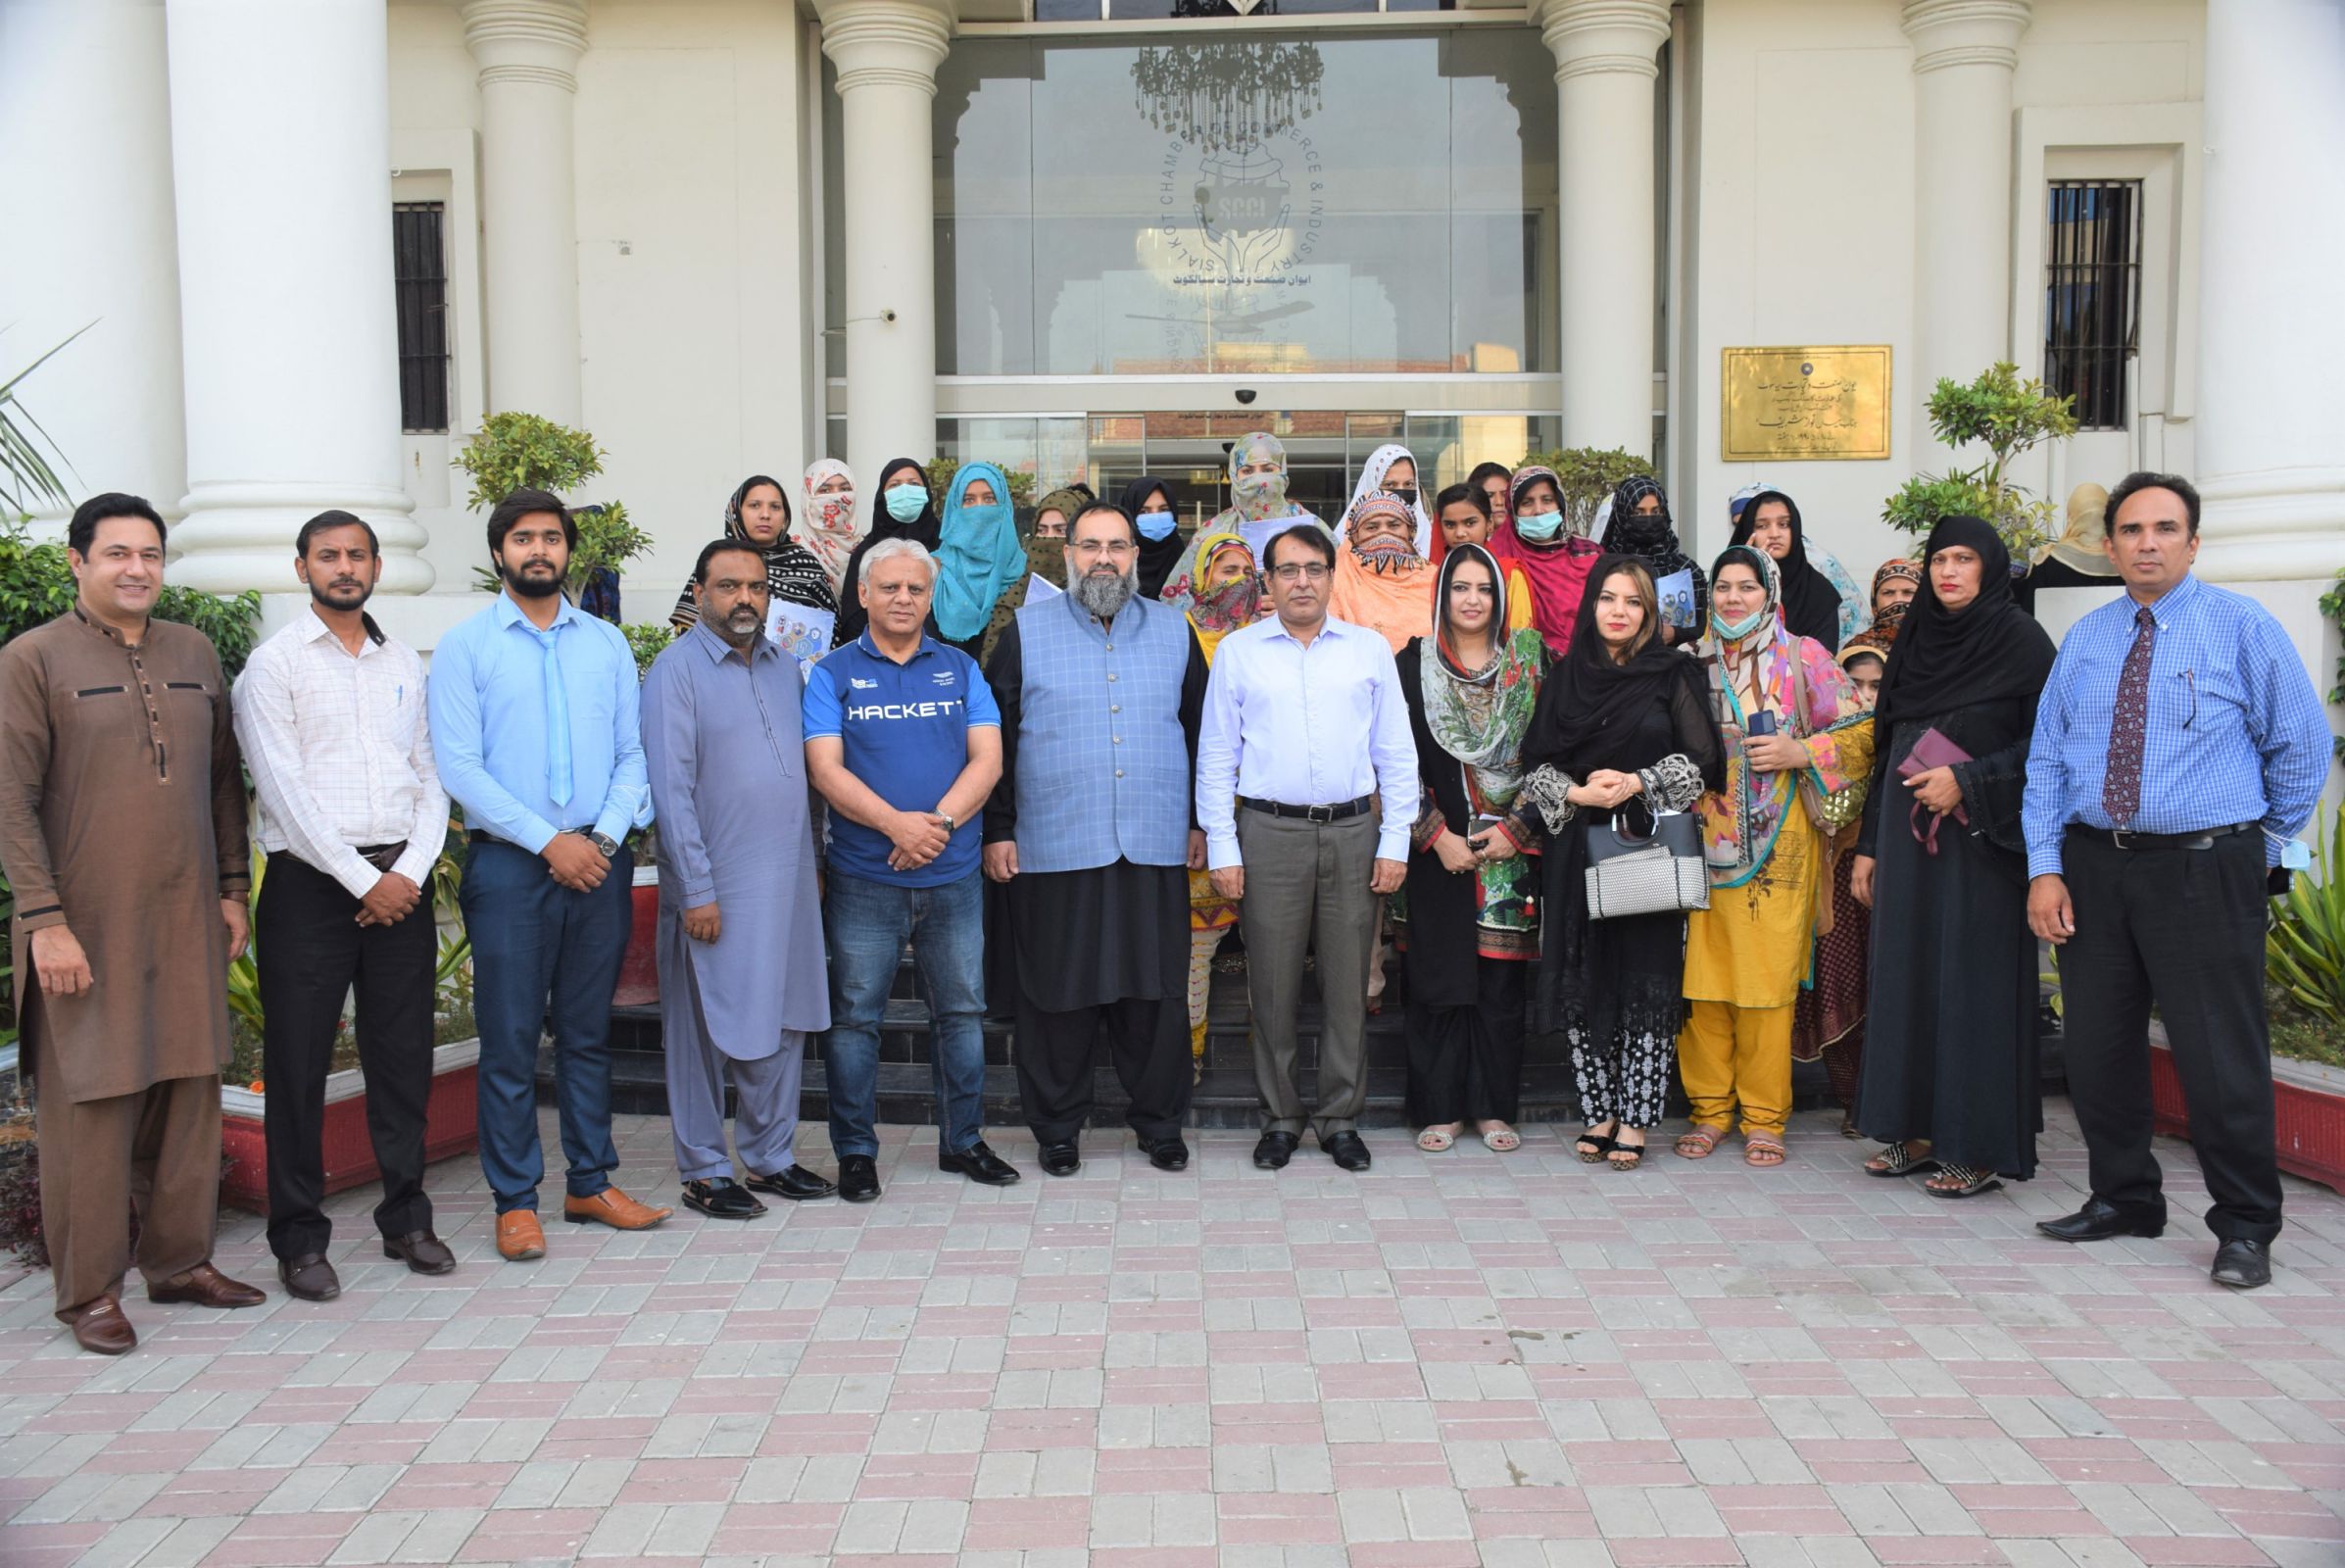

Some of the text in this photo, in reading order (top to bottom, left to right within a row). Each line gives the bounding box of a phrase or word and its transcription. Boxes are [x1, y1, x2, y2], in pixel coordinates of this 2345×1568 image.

[1309, 182, 1323, 191] &
[1162, 214, 1215, 271] SIALKOT
[1271, 199, 1323, 271] INDUSTRY
